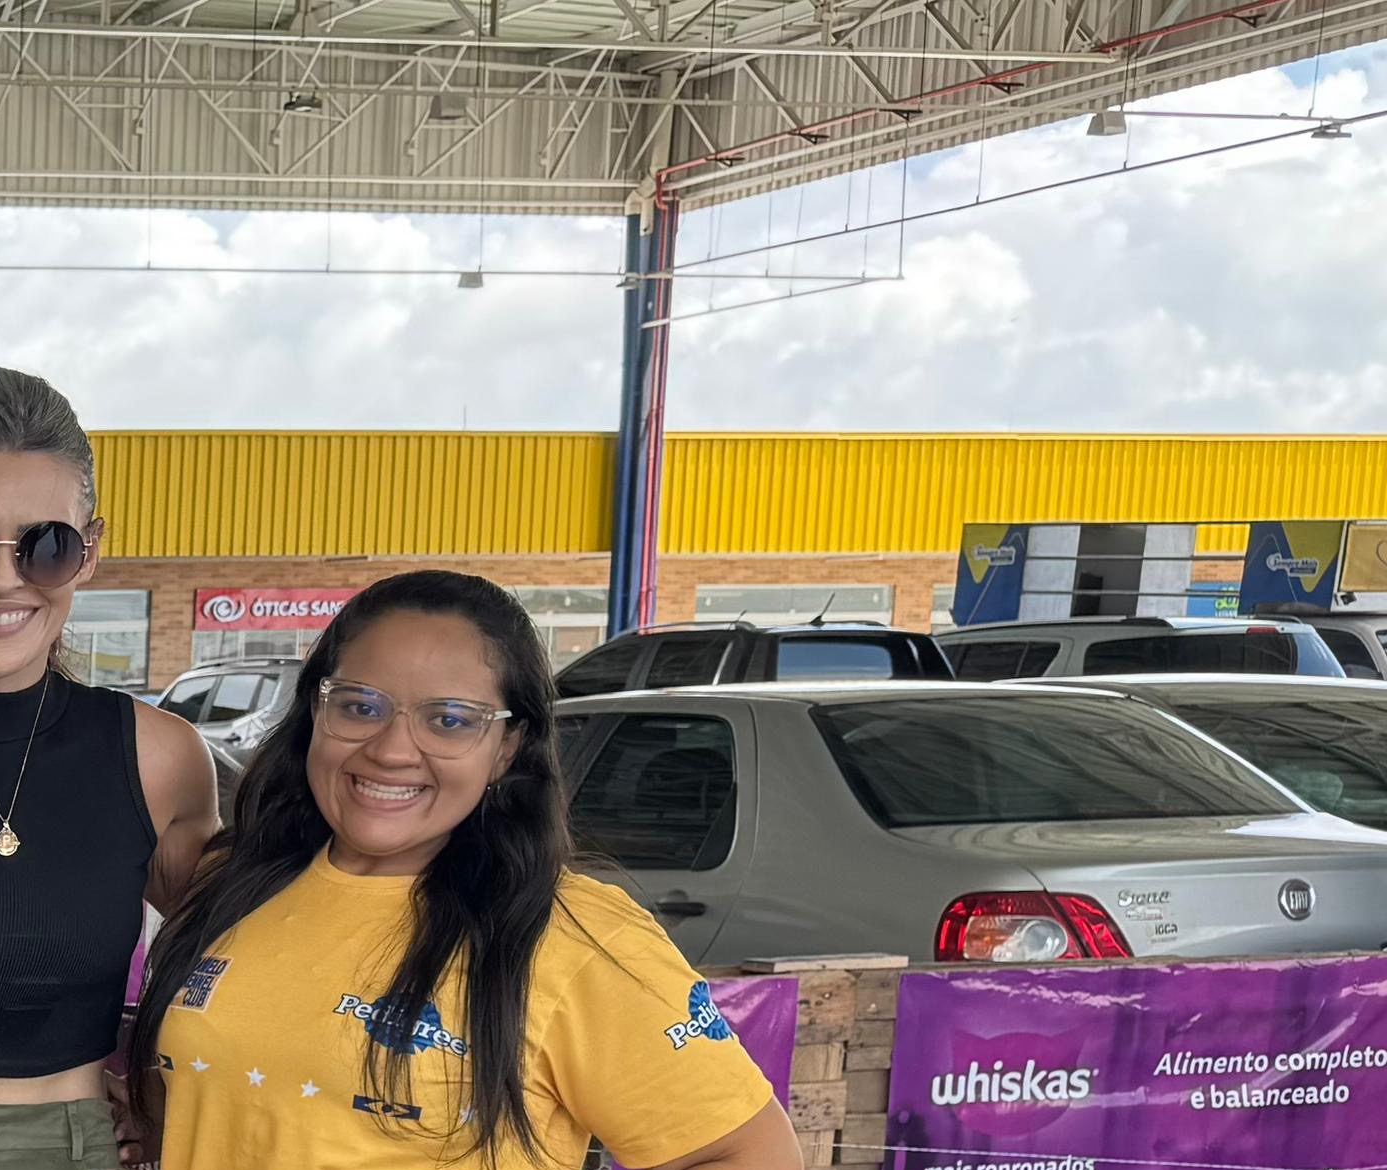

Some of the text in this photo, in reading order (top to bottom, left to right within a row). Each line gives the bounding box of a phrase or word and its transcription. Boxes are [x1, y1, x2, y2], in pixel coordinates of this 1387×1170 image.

[251, 598, 307, 617] ÓTICAS
[1153, 1044, 1387, 1076] Alimento completo
[931, 1059, 1099, 1105] whiskas
[1190, 1079, 1350, 1109] e balanceado
